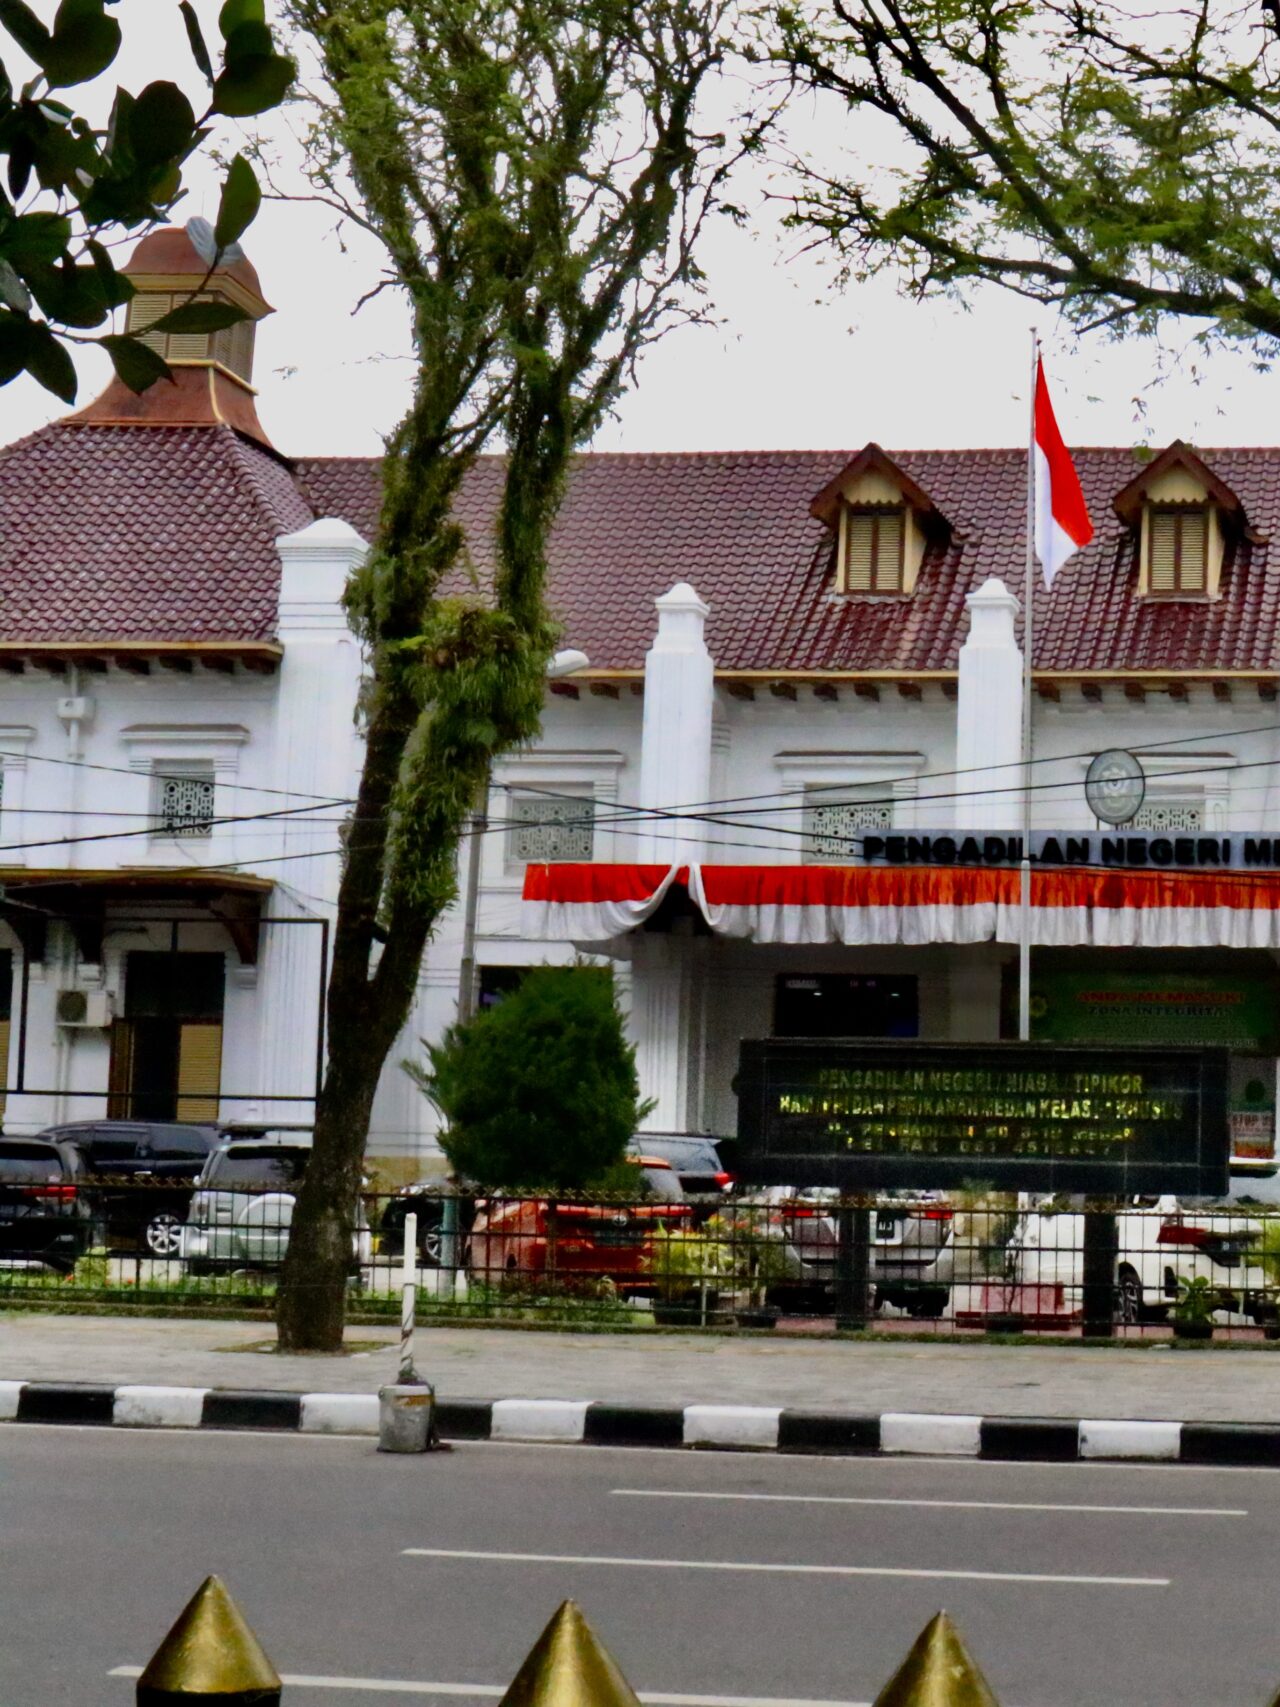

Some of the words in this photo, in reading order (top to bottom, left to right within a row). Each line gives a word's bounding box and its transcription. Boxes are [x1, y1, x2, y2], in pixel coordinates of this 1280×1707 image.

[863, 836, 1090, 863] PENGADILAN
[1101, 837, 1231, 865] NEGERI
[1088, 1006, 1132, 1016] ZONA
[1136, 1006, 1234, 1017] INTEGRITAS
[819, 1070, 925, 1090] PENGADILAN
[930, 1072, 992, 1091] NEGERI
[1074, 1074, 1143, 1094] TIPIKOR
[1040, 1099, 1091, 1119] KELAS
